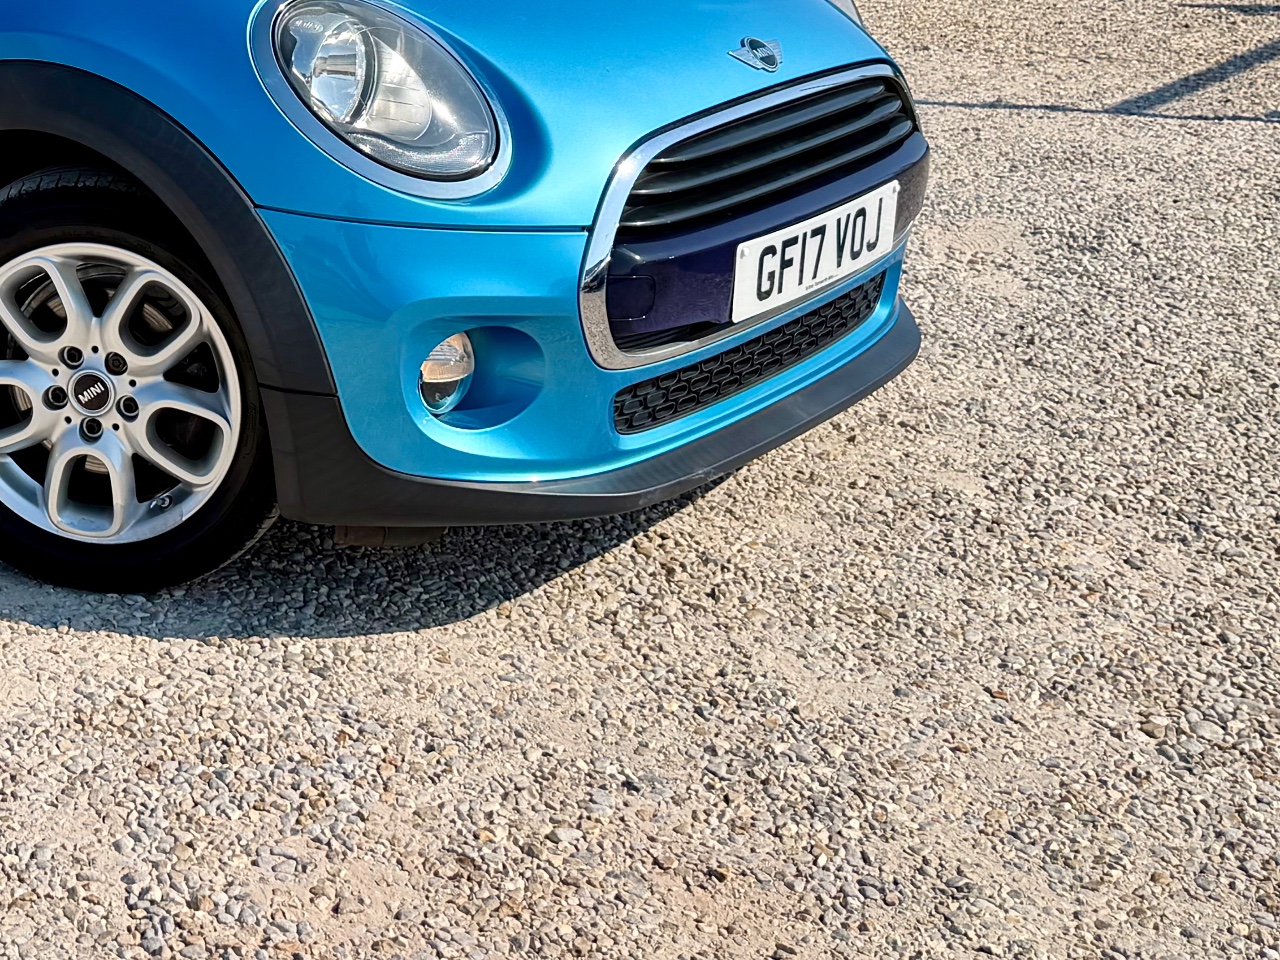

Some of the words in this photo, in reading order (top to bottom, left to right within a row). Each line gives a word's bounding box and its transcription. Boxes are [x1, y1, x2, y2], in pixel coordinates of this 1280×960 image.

[755, 223, 827, 302] GF17
[836, 197, 883, 269] VOJ
[77, 381, 105, 404] MINI
